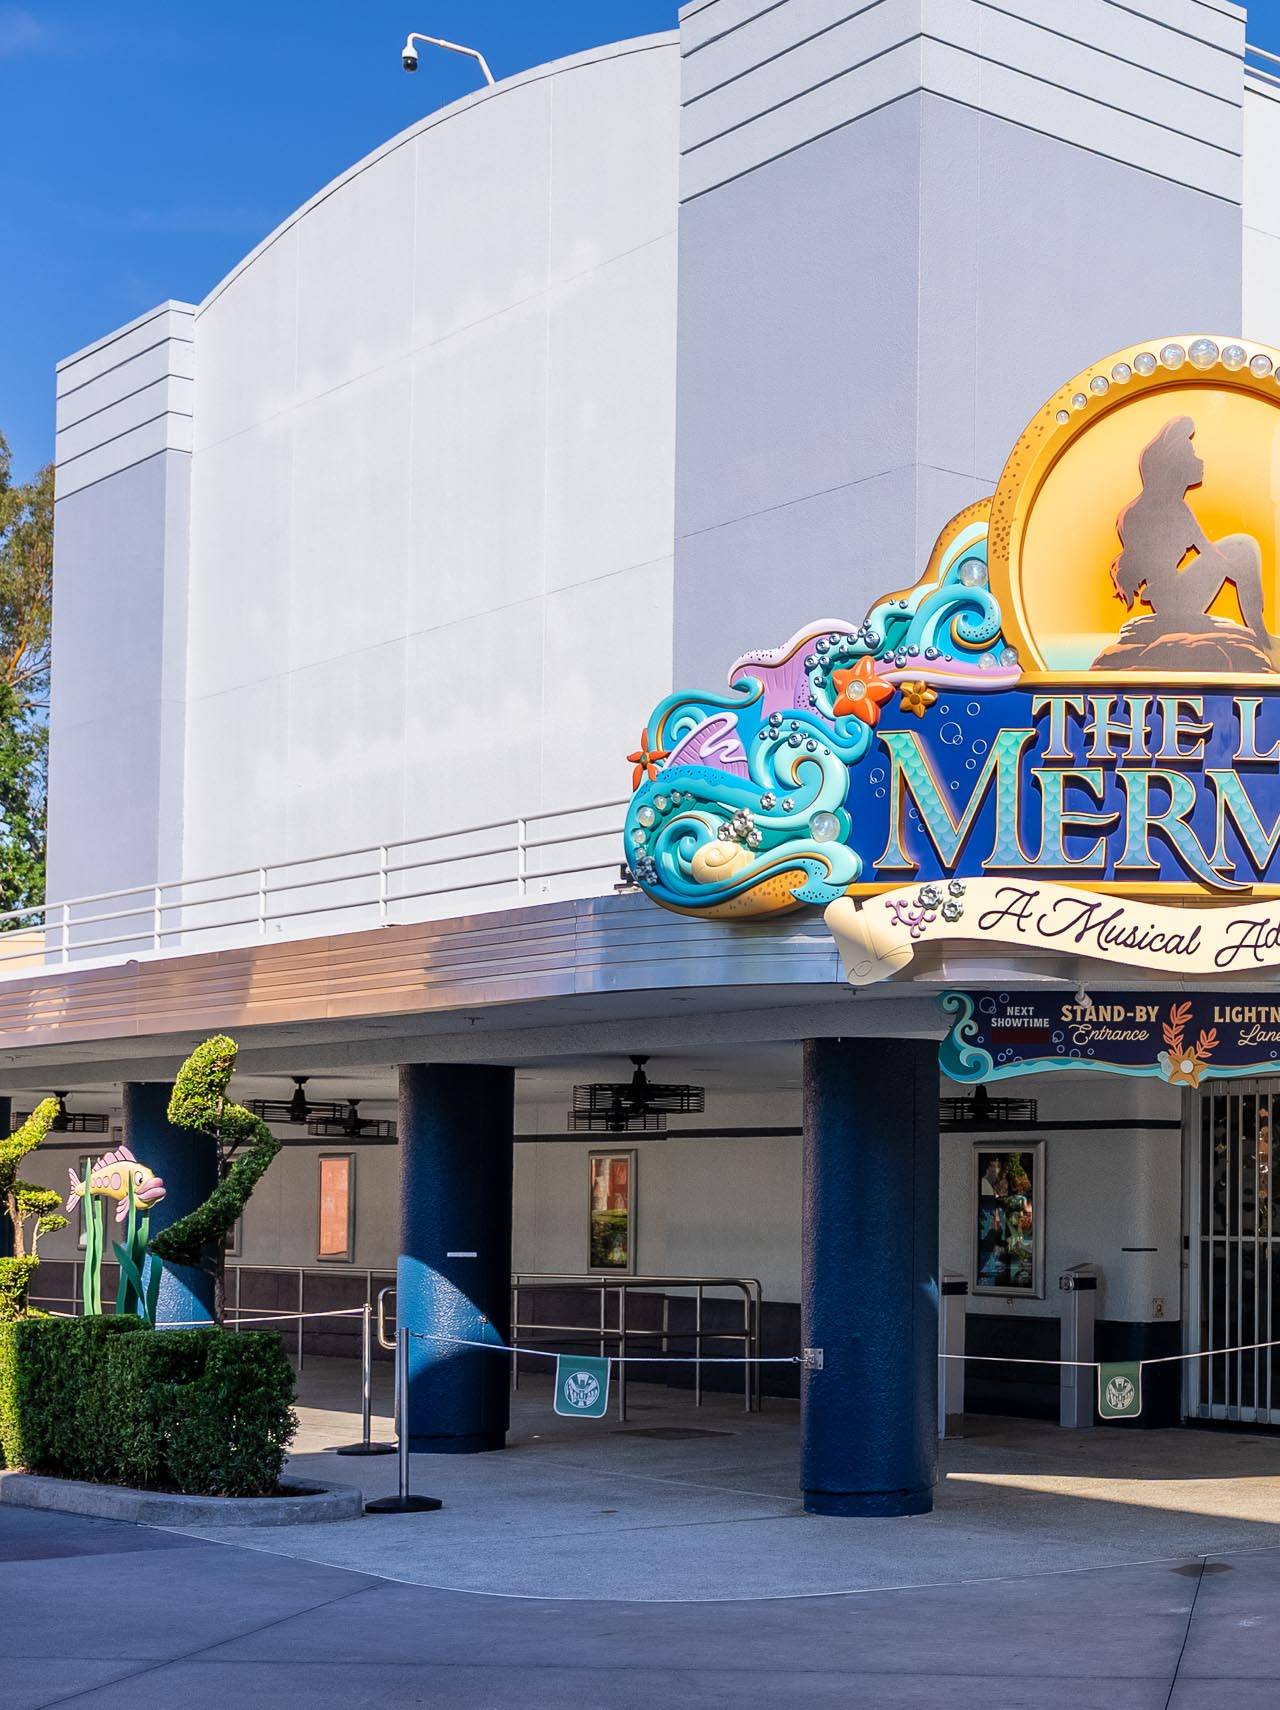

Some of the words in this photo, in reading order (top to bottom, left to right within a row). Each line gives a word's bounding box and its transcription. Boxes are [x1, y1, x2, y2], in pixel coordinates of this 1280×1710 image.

[1031, 694, 1214, 761] THE
[978, 886, 1040, 932] A
[1036, 897, 1203, 956] Musical
[1006, 1006, 1035, 1017] NEXT
[1060, 1004, 1160, 1023] STAND-BY
[990, 1017, 1050, 1029] SHOWTIME
[1068, 1023, 1150, 1046] Entrance
